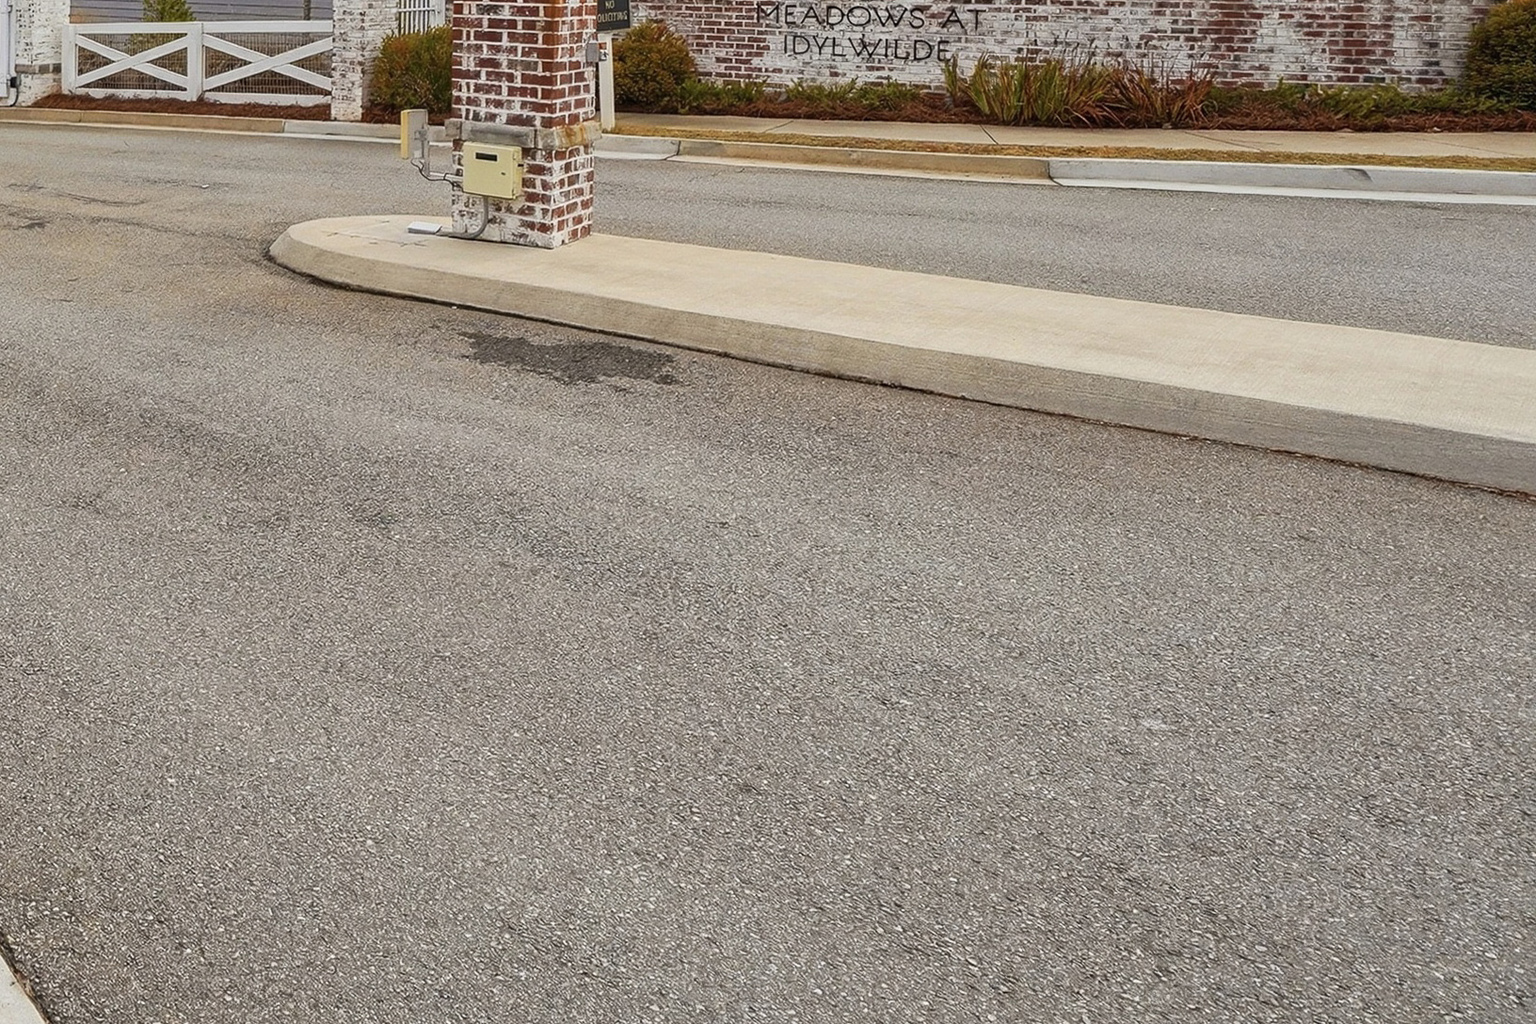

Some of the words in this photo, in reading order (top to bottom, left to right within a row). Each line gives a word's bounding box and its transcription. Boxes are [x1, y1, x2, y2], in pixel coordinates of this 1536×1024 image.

[605, 0, 615, 9] NO
[756, 2, 925, 28] MEADOWS
[941, 8, 987, 31] AT
[783, 35, 951, 61] IDYLWILDE
